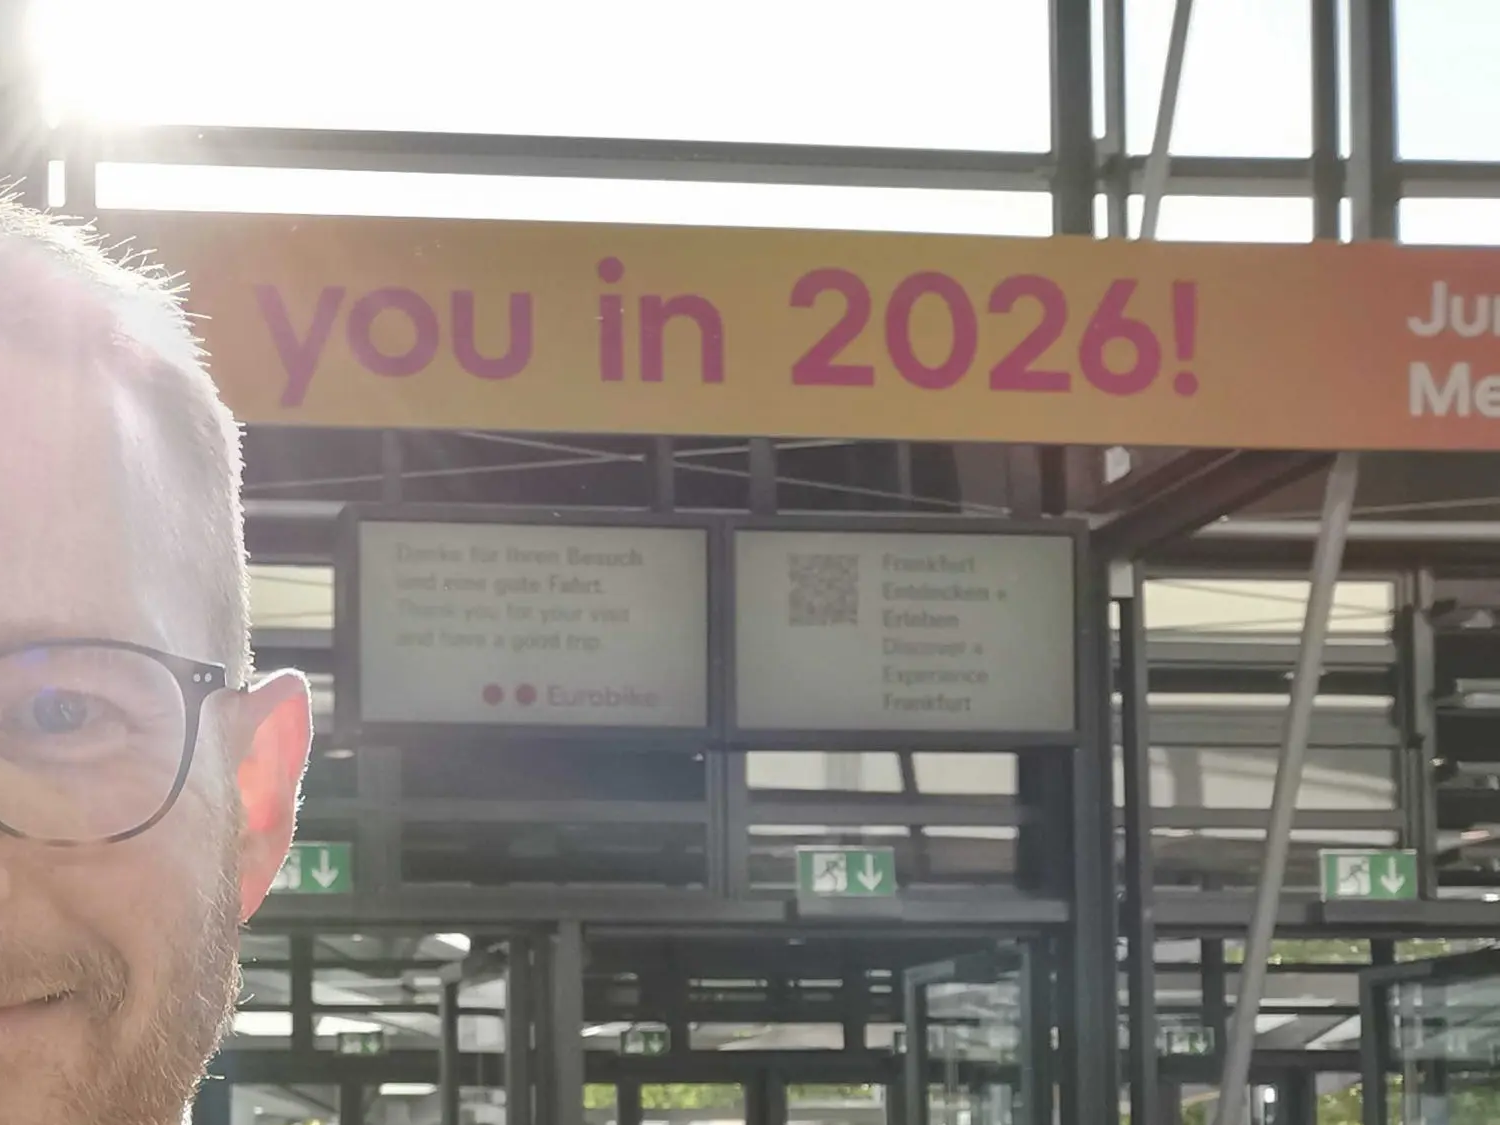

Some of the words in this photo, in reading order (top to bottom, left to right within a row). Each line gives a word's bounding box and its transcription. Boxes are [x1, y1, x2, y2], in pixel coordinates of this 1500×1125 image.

[252, 282, 534, 405] you
[595, 256, 725, 384] in
[789, 266, 1201, 399] 2026!
